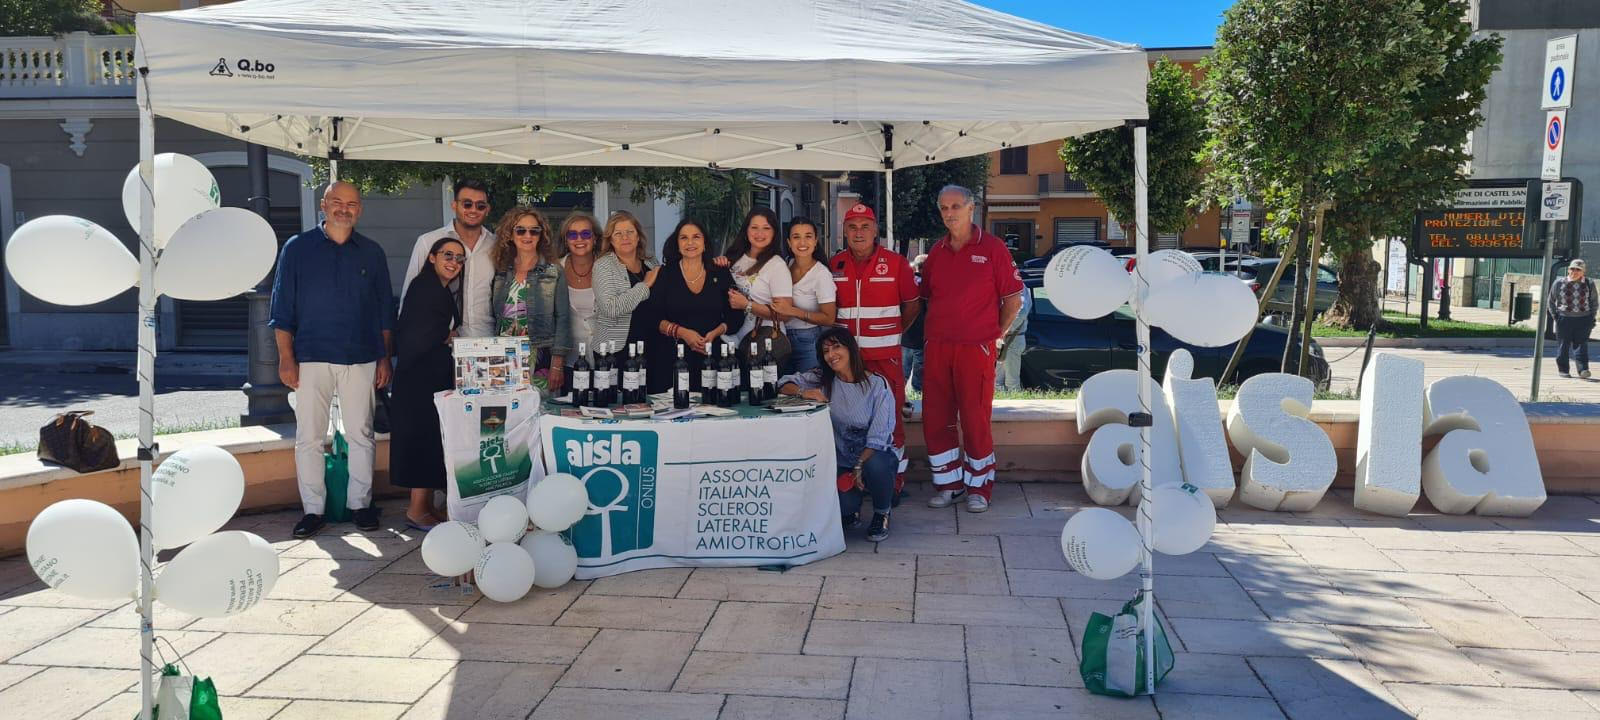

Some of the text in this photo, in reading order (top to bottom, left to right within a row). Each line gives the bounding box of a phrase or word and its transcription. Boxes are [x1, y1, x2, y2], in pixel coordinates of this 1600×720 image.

[237, 58, 275, 73] Q.bo
[1424, 219, 1503, 228] PROTEZIONE
[1444, 212, 1490, 221] NUMERI
[1429, 233, 1457, 241] TEL.
[1431, 239, 1461, 248] CEL.
[1076, 349, 1547, 518] aisla
[565, 433, 642, 468] aisla
[698, 464, 817, 484] ASSOCIAZIONE
[641, 466, 656, 510] ONLUS
[698, 484, 771, 501] ITALIANA
[697, 501, 773, 517] SCLEROSI
[697, 518, 769, 534] LATERALE
[695, 532, 818, 551] AMIOTROFICA
[246, 568, 255, 586] CHE
